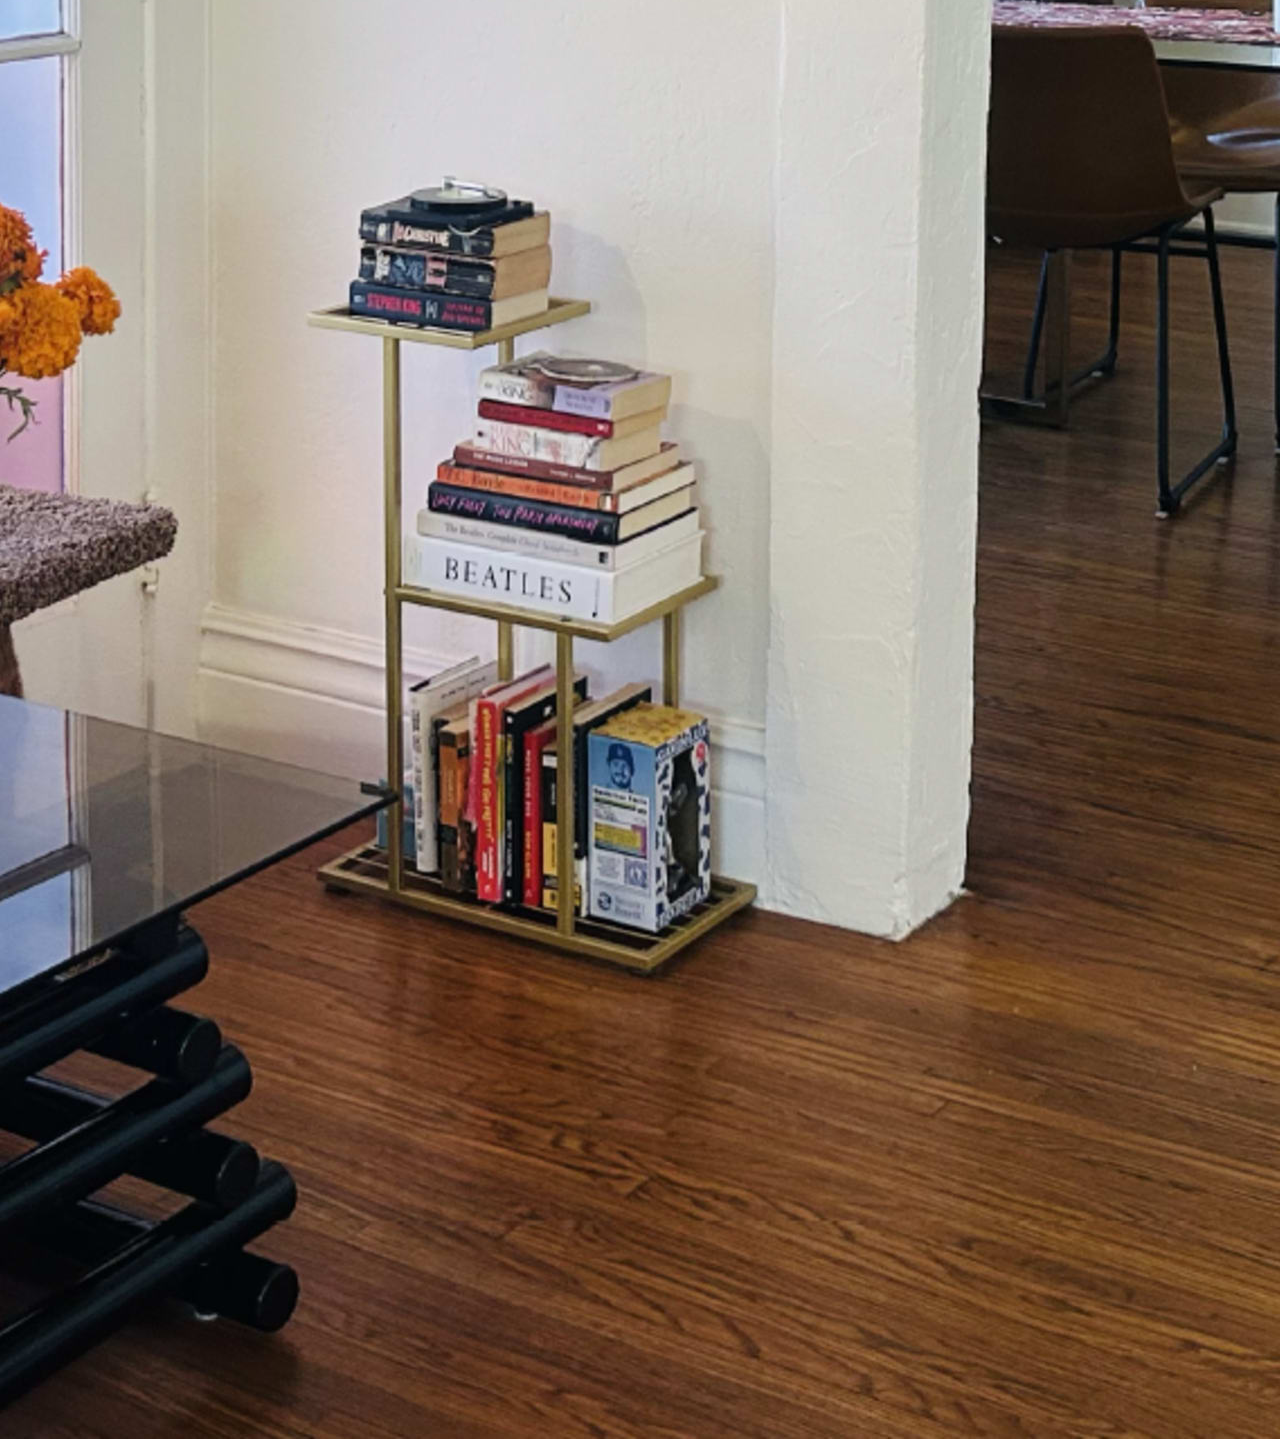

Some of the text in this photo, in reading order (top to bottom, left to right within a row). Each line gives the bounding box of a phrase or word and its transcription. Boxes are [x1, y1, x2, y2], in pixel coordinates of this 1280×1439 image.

[432, 492, 456, 509] LUCY
[445, 522, 459, 533] The
[445, 556, 573, 605] BEATLES
